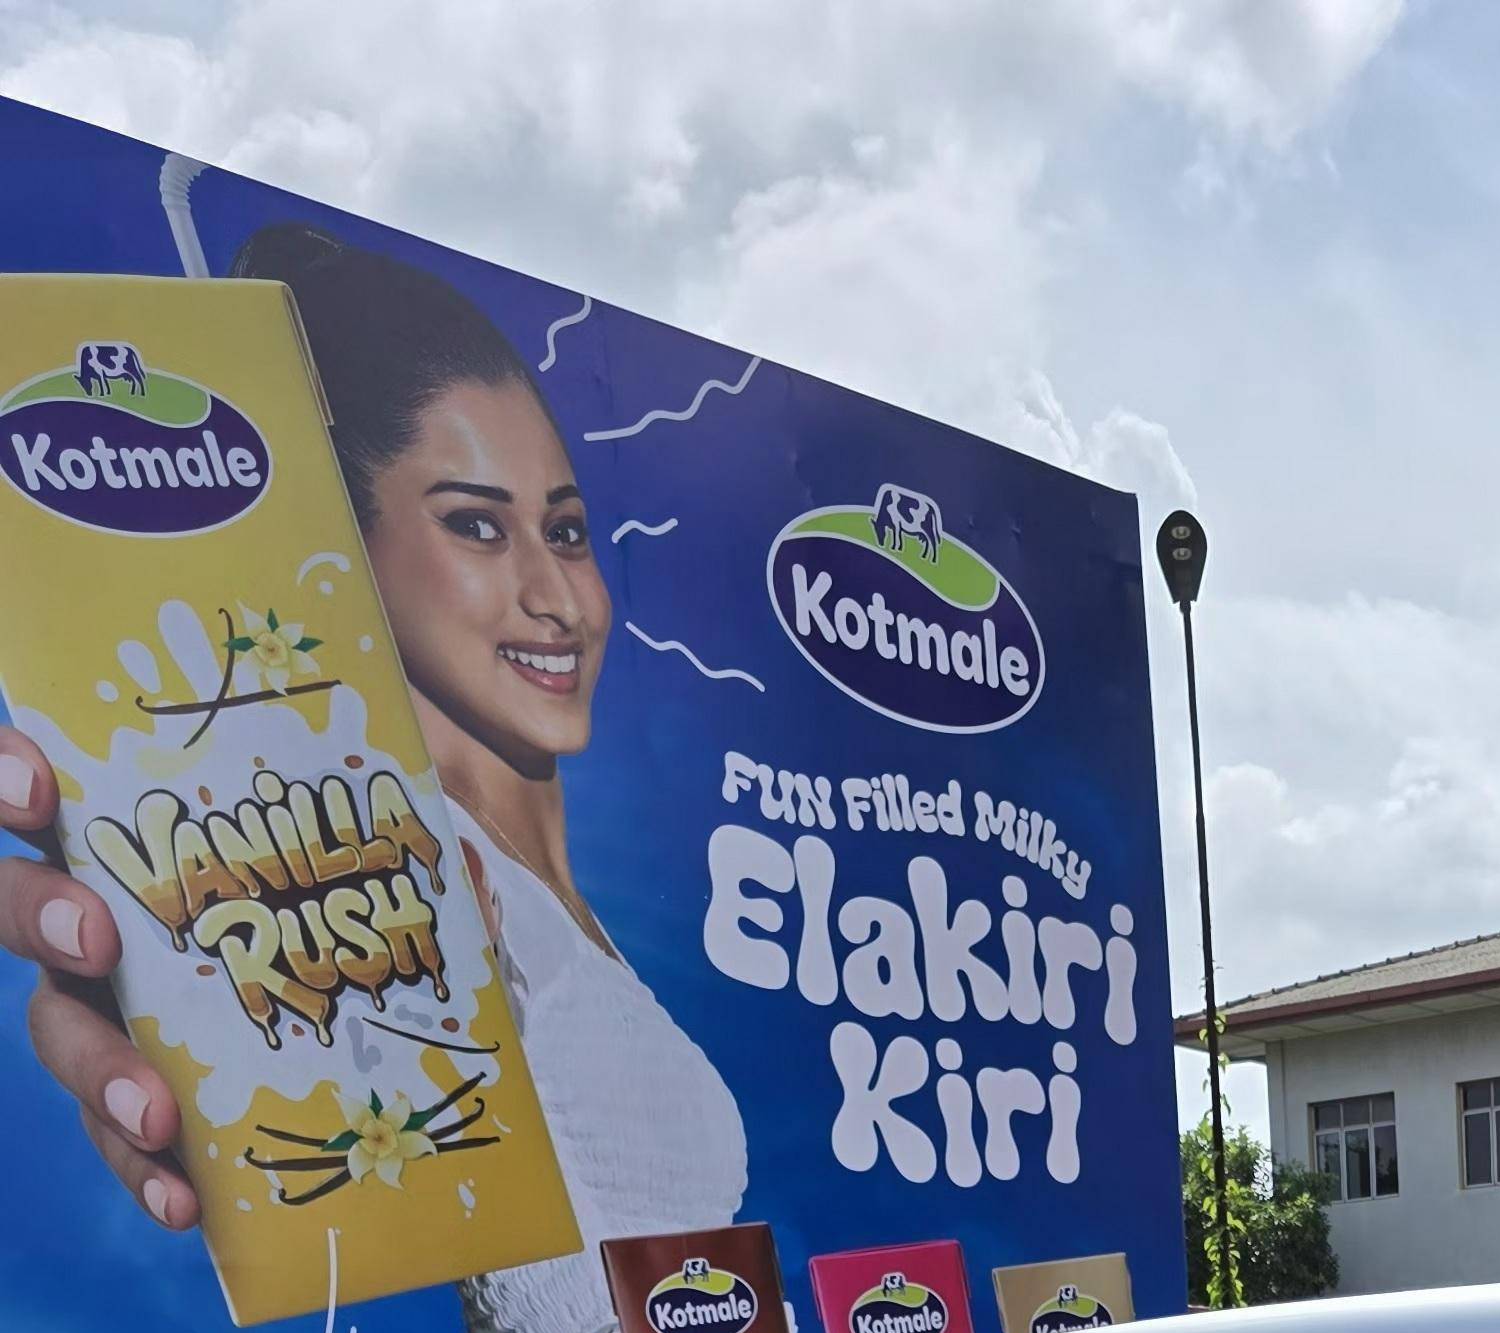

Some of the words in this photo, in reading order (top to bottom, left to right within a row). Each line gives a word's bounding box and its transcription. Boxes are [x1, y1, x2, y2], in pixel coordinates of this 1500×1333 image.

[12, 430, 261, 491] Kotmale
[790, 563, 1032, 700] Kotmale
[721, 751, 837, 830] FUN
[846, 774, 965, 838] Filled
[974, 790, 1093, 901] Milky
[192, 873, 450, 1050] RUSH
[703, 824, 1138, 1046] Elakiri
[829, 1021, 1082, 1189] Kiri
[654, 1296, 752, 1330] Kotmale
